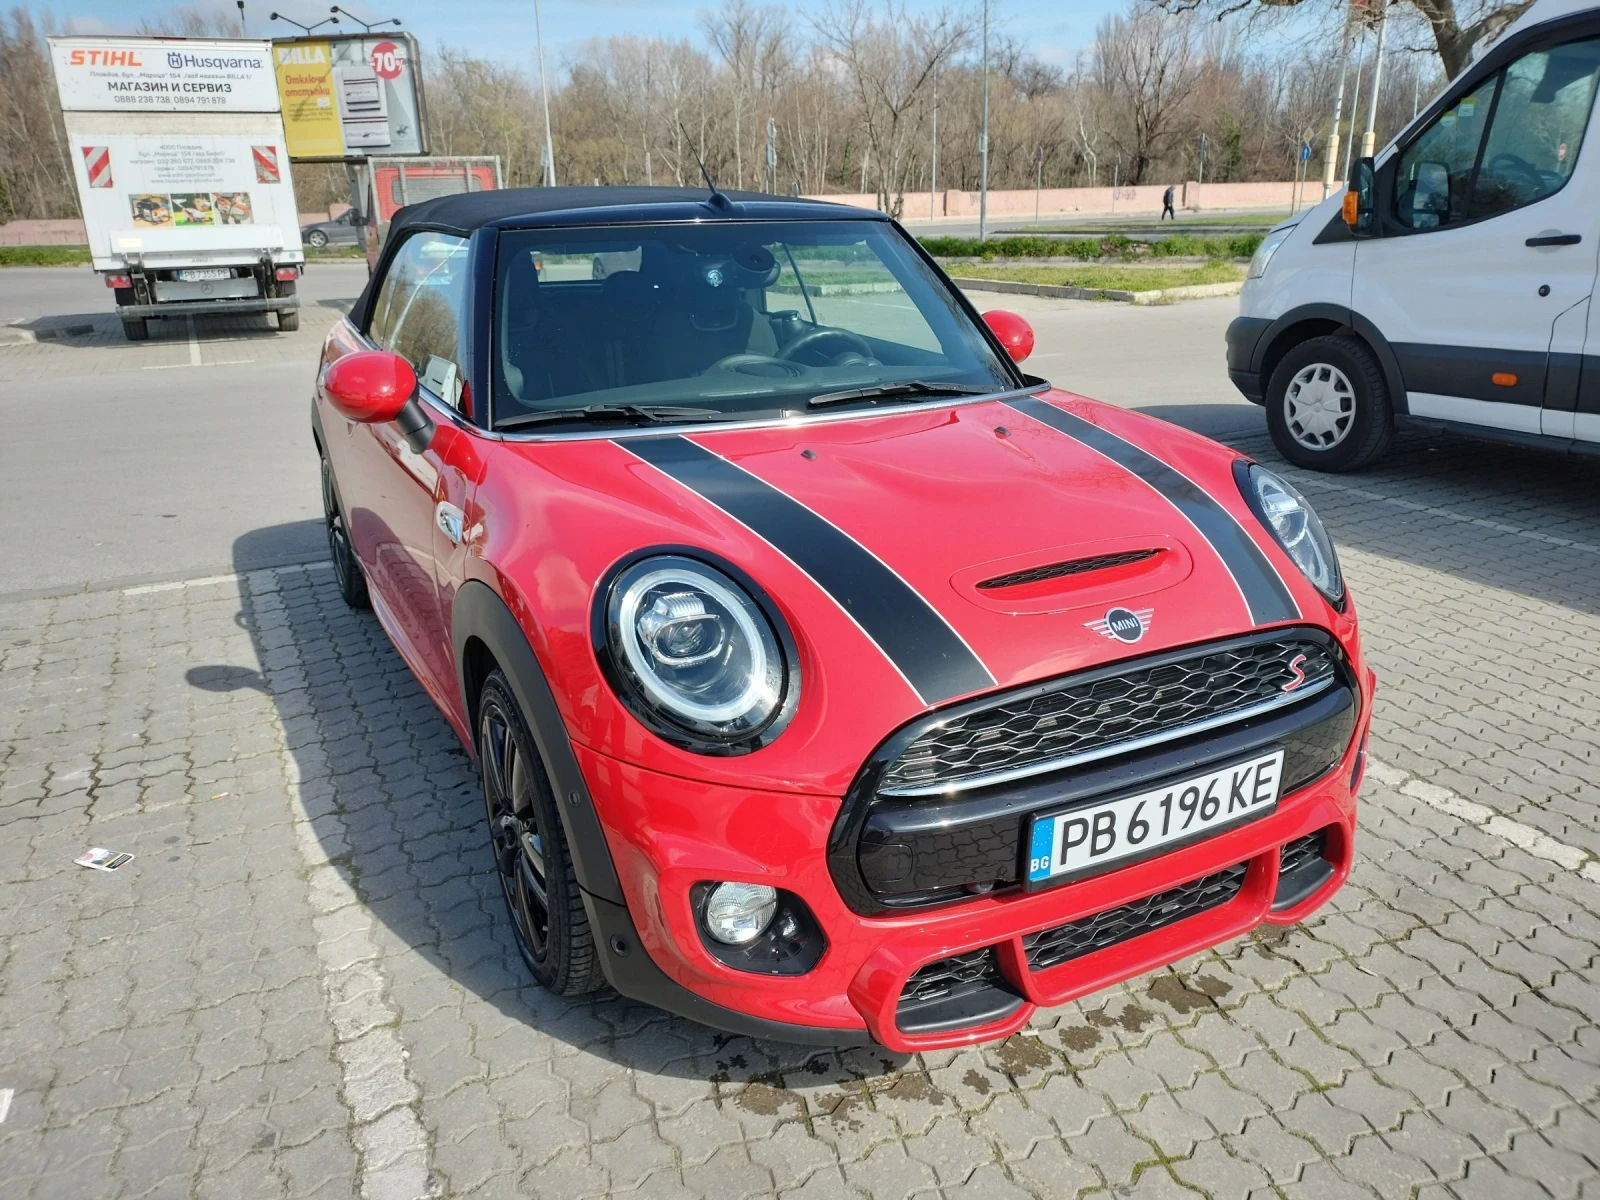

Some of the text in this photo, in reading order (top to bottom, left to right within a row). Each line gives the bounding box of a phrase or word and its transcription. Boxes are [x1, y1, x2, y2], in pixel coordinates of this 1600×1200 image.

[70, 49, 142, 67] STIHL
[184, 55, 261, 70] Husqvarna
[278, 47, 326, 65] BILLA
[108, 82, 232, 93] МАГАЗИН И СЕРВИЗ
[114, 95, 136, 104] 0888
[138, 96, 154, 104] 238
[174, 96, 195, 104] 0894
[197, 96, 210, 104] 791
[1111, 617, 1138, 632] MINI
[1281, 653, 1307, 692] S
[1060, 758, 1277, 866] PB 6196 KE
[1030, 855, 1050, 872] BG
